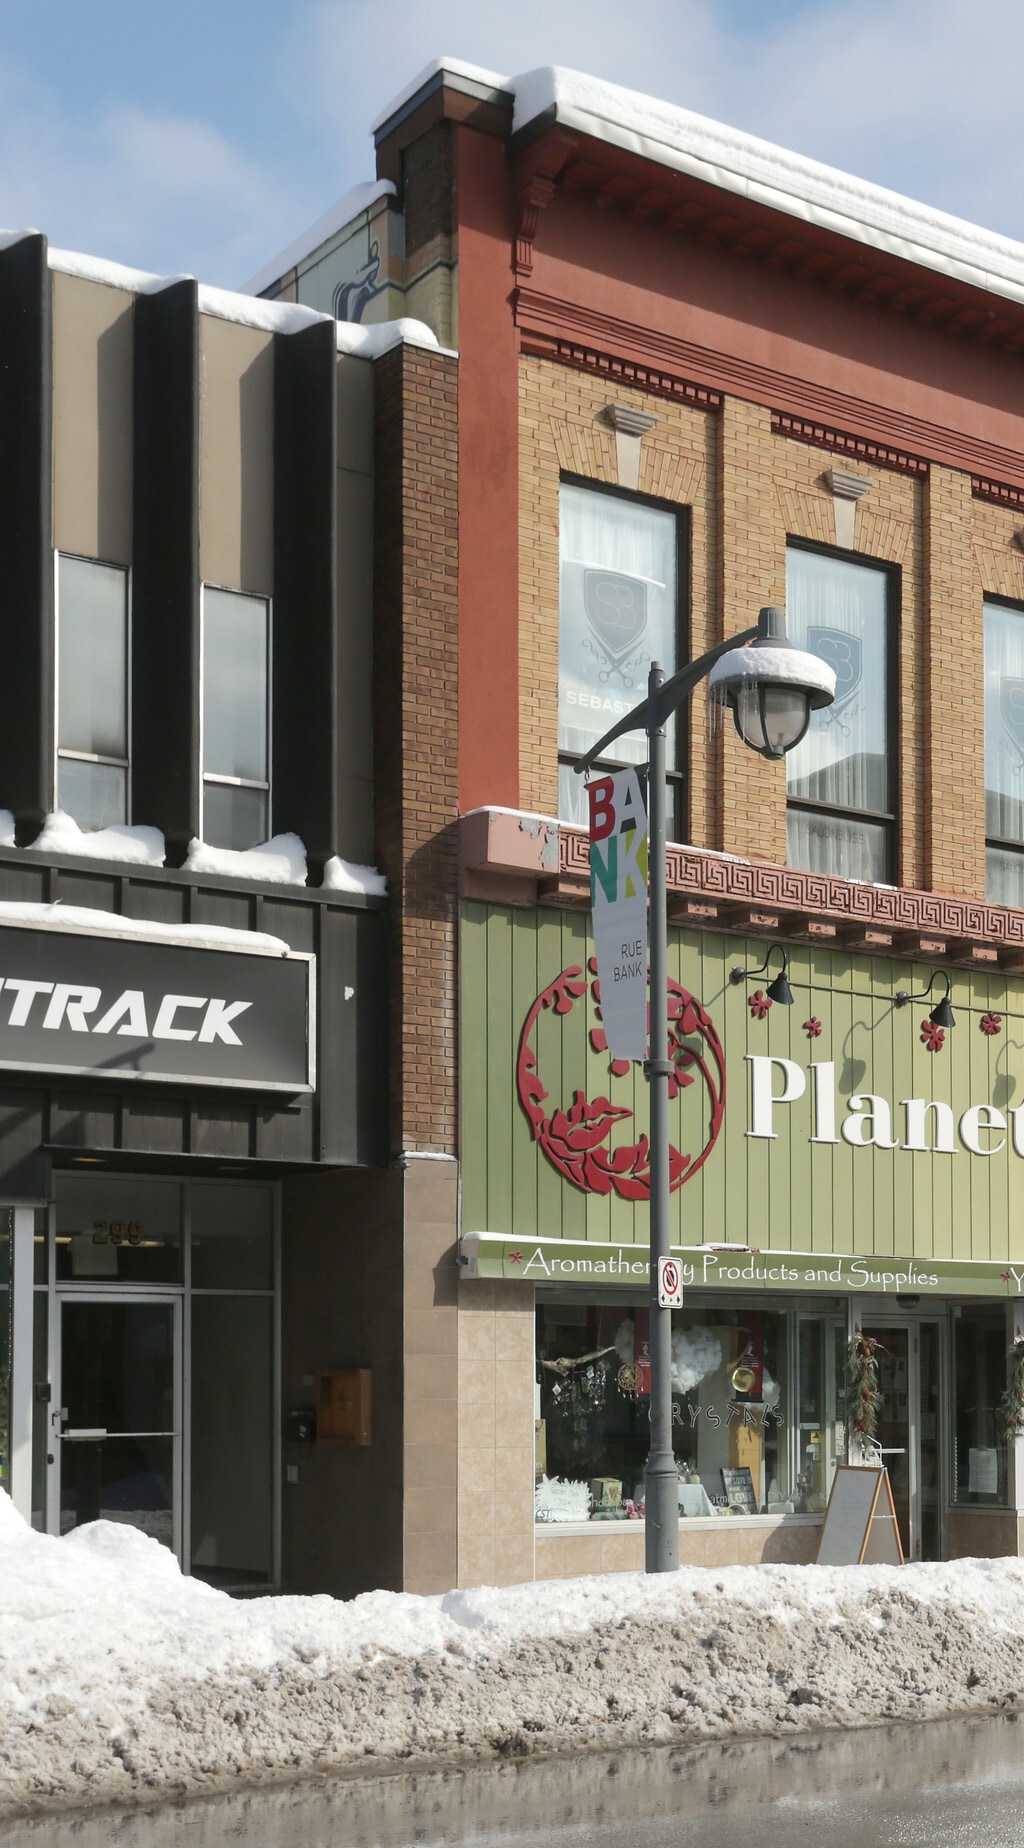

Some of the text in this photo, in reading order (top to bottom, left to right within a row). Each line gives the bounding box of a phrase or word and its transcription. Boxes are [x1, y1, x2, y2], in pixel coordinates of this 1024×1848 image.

[621, 940, 643, 960] RUE
[613, 962, 643, 982] BANK
[0, 978, 254, 1046] TRACK
[92, 1219, 144, 1245] 299
[522, 1247, 939, 1292] Aromathery Products and Supplies
[648, 1402, 784, 1429] RYSTALS
